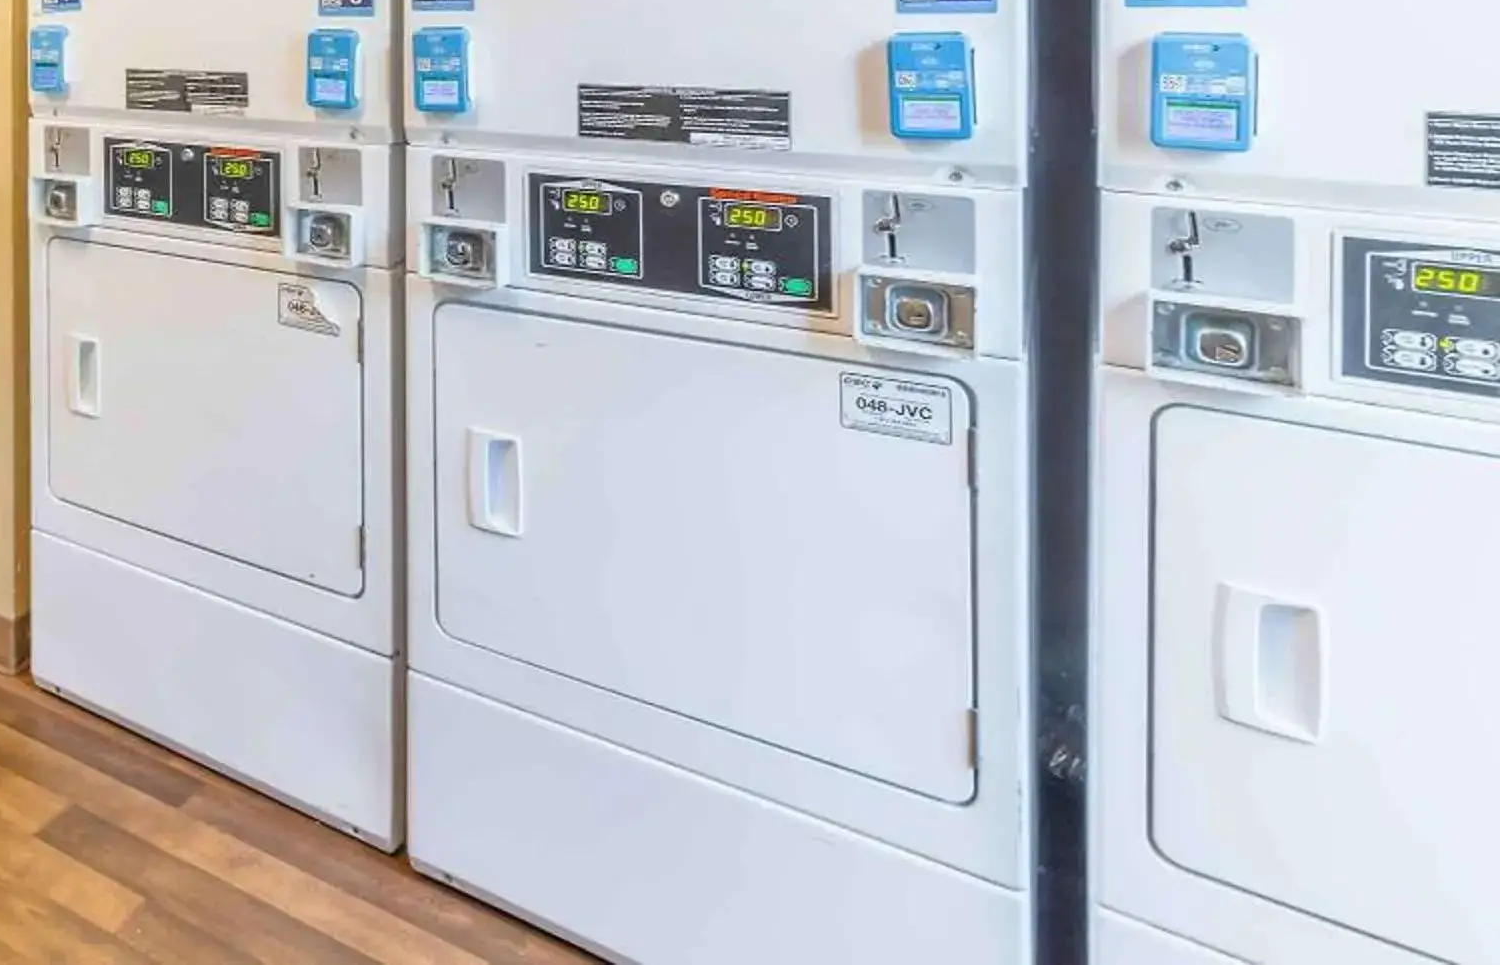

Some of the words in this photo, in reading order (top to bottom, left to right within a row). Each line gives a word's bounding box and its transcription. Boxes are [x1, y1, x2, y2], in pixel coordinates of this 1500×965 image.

[566, 193, 600, 210] 250
[729, 208, 766, 225] 250
[1414, 268, 1479, 293] 250
[856, 395, 933, 420] 048-JVC
